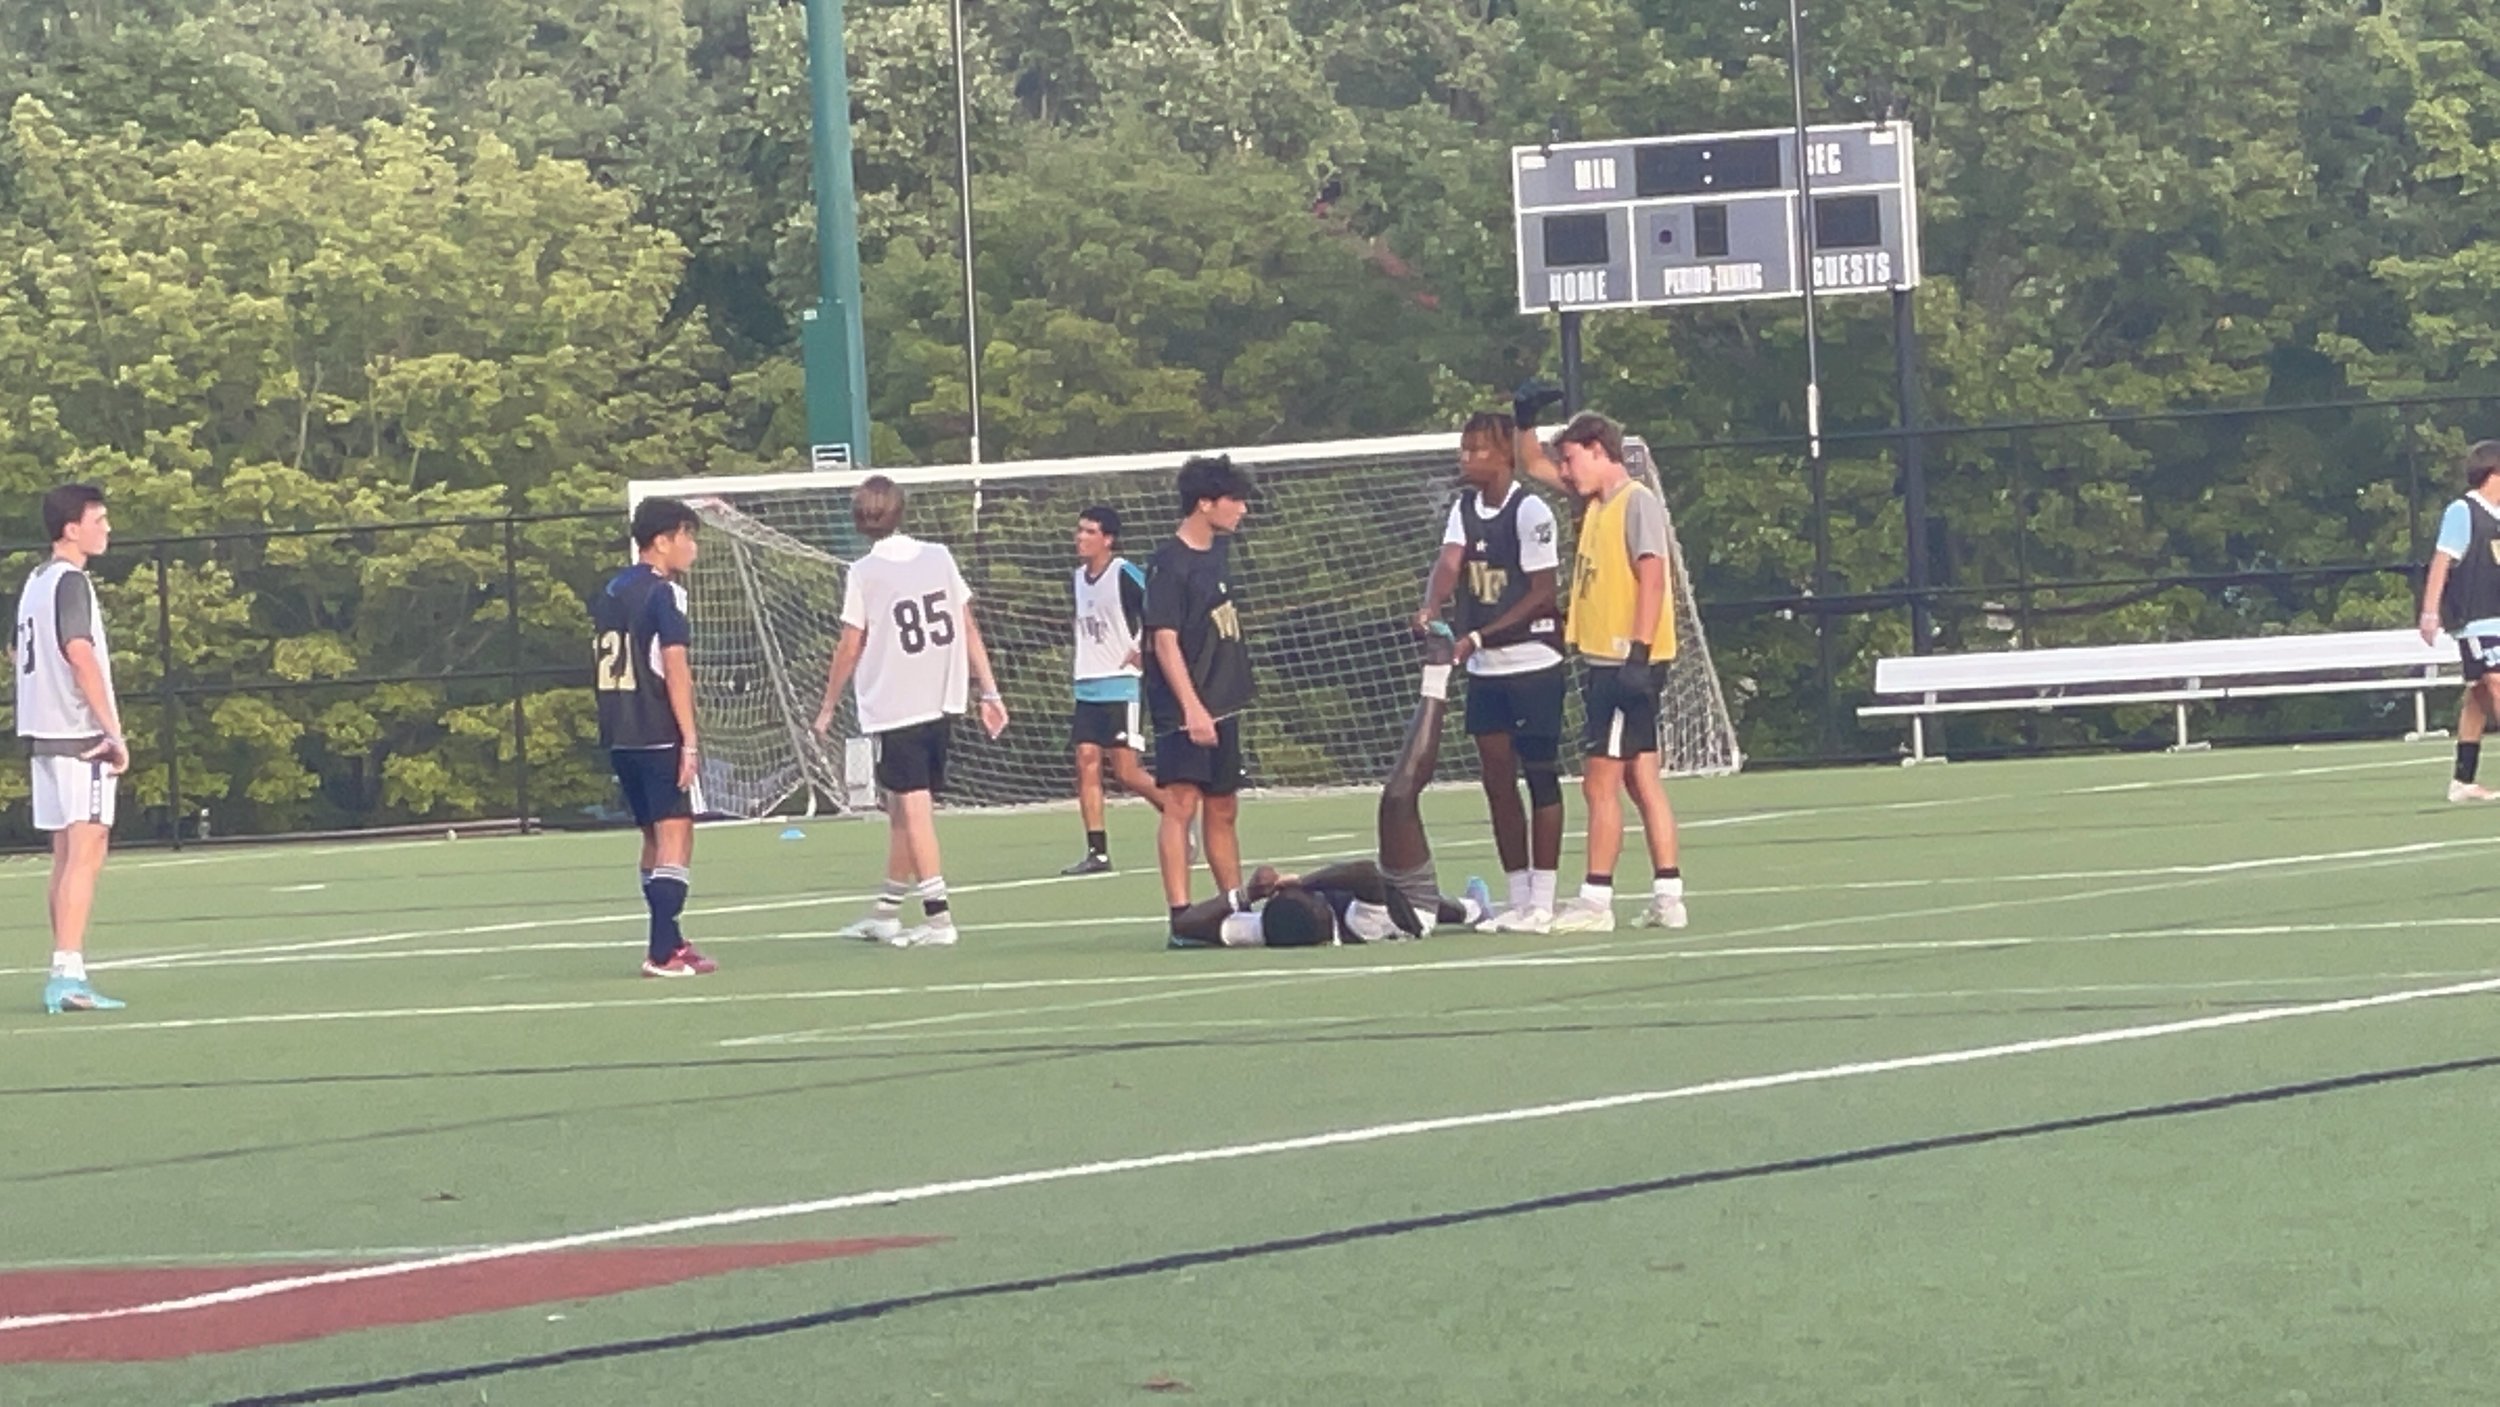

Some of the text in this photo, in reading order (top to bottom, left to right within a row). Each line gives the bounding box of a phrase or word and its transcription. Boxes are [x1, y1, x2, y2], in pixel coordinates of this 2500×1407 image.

[1812, 252, 1890, 286] GUESTS
[1549, 270, 1608, 303] HOME
[893, 589, 955, 655] 85
